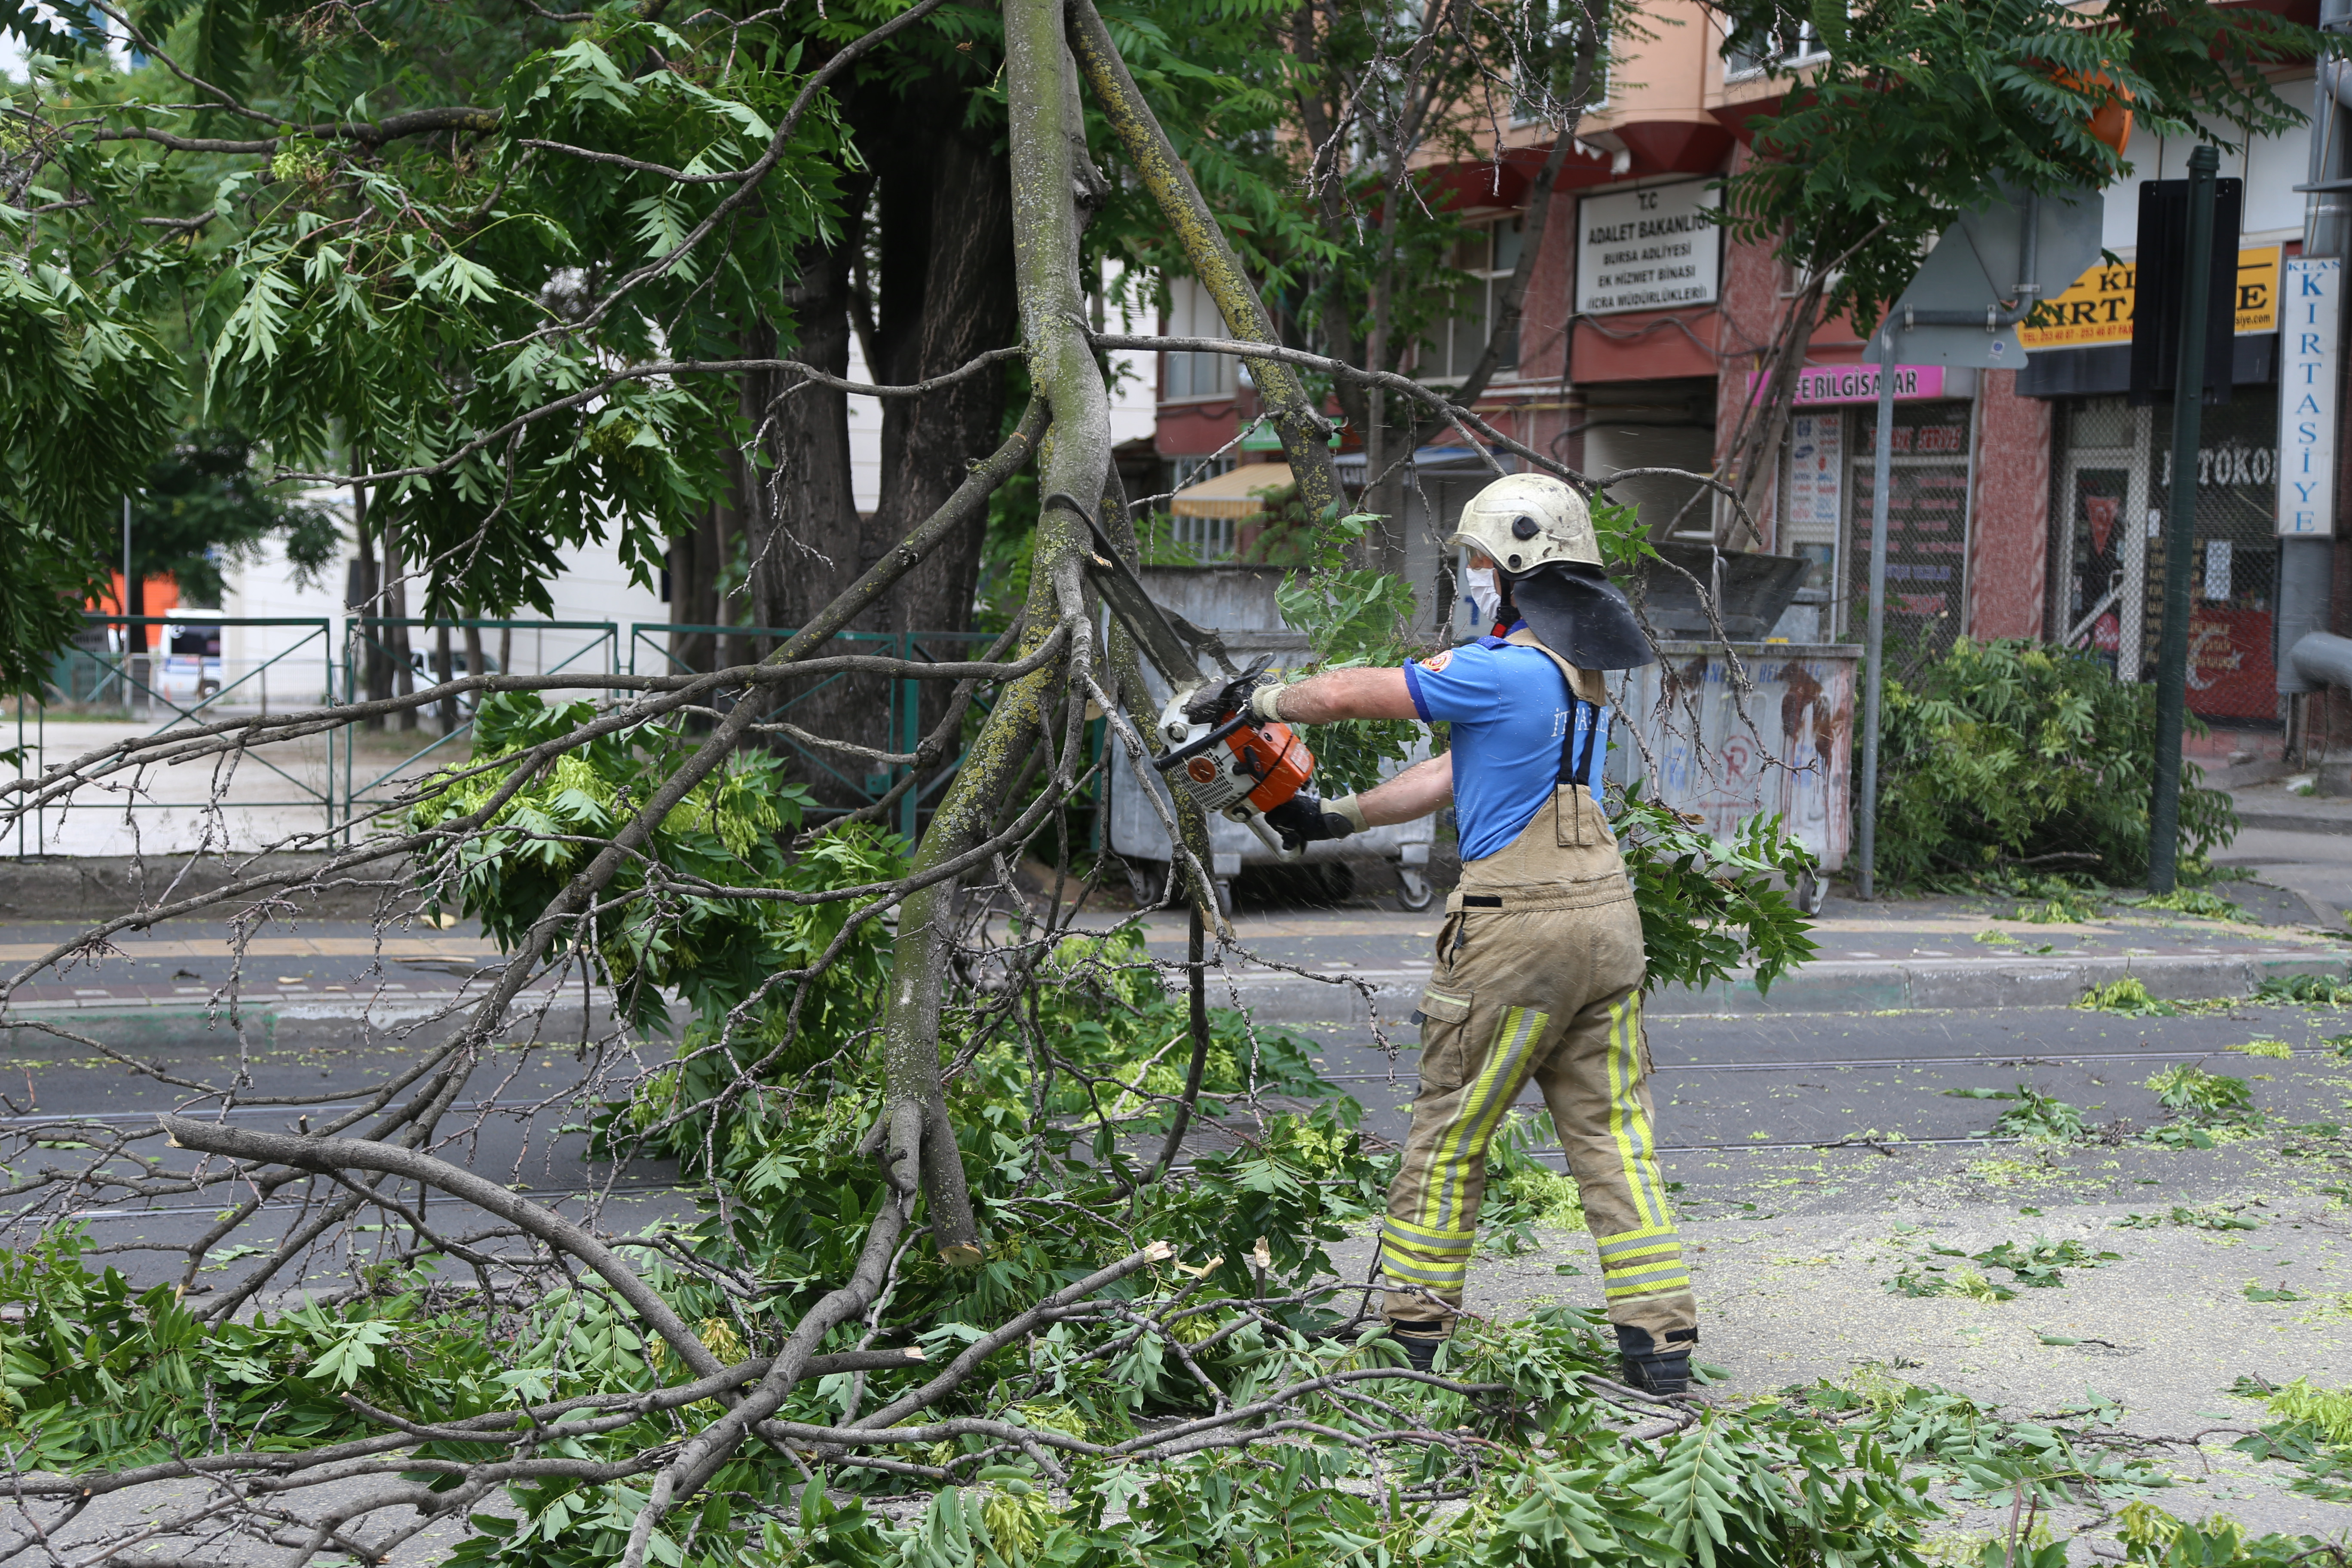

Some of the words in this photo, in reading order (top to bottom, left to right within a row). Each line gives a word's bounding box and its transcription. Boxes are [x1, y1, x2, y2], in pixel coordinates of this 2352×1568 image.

[1588, 222, 1636, 244] ADALET
[1603, 249, 1638, 266] BURSA
[1640, 239, 1692, 261] ADLİYESİ
[1598, 274, 1612, 288] EK
[1614, 270, 1655, 285] HİZMET
[1657, 264, 1696, 281] BİNASI
[2288, 260, 2340, 271] KLAS
[1814, 367, 1918, 402] BİLGİSAAR
[2293, 272, 2324, 532] KIRTASİYE
